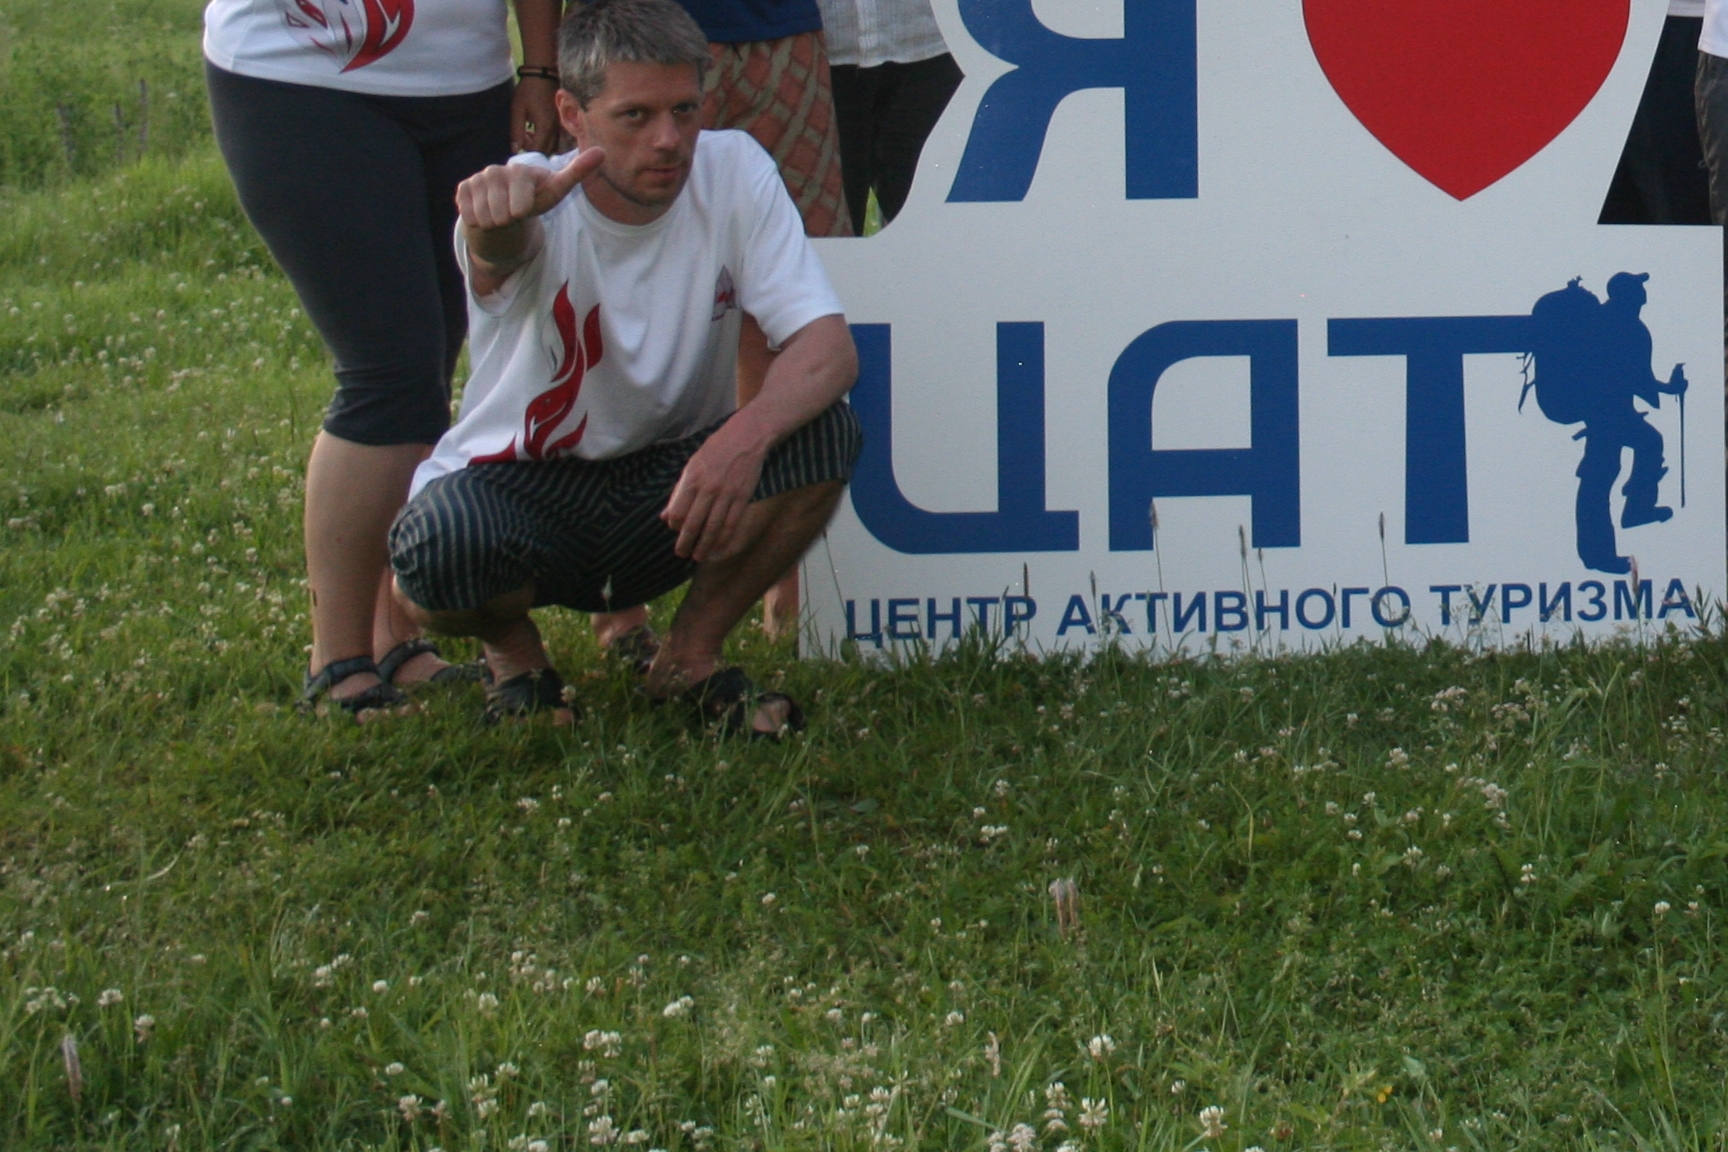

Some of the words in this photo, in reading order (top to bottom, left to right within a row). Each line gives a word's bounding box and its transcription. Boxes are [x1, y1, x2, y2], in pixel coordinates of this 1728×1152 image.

[849, 314, 1537, 555] ЦАТ
[845, 595, 1038, 648] ЦЕНТР
[1056, 586, 1412, 636] АКТИВНОГО
[1429, 578, 1700, 626] ТУРИЗМА
